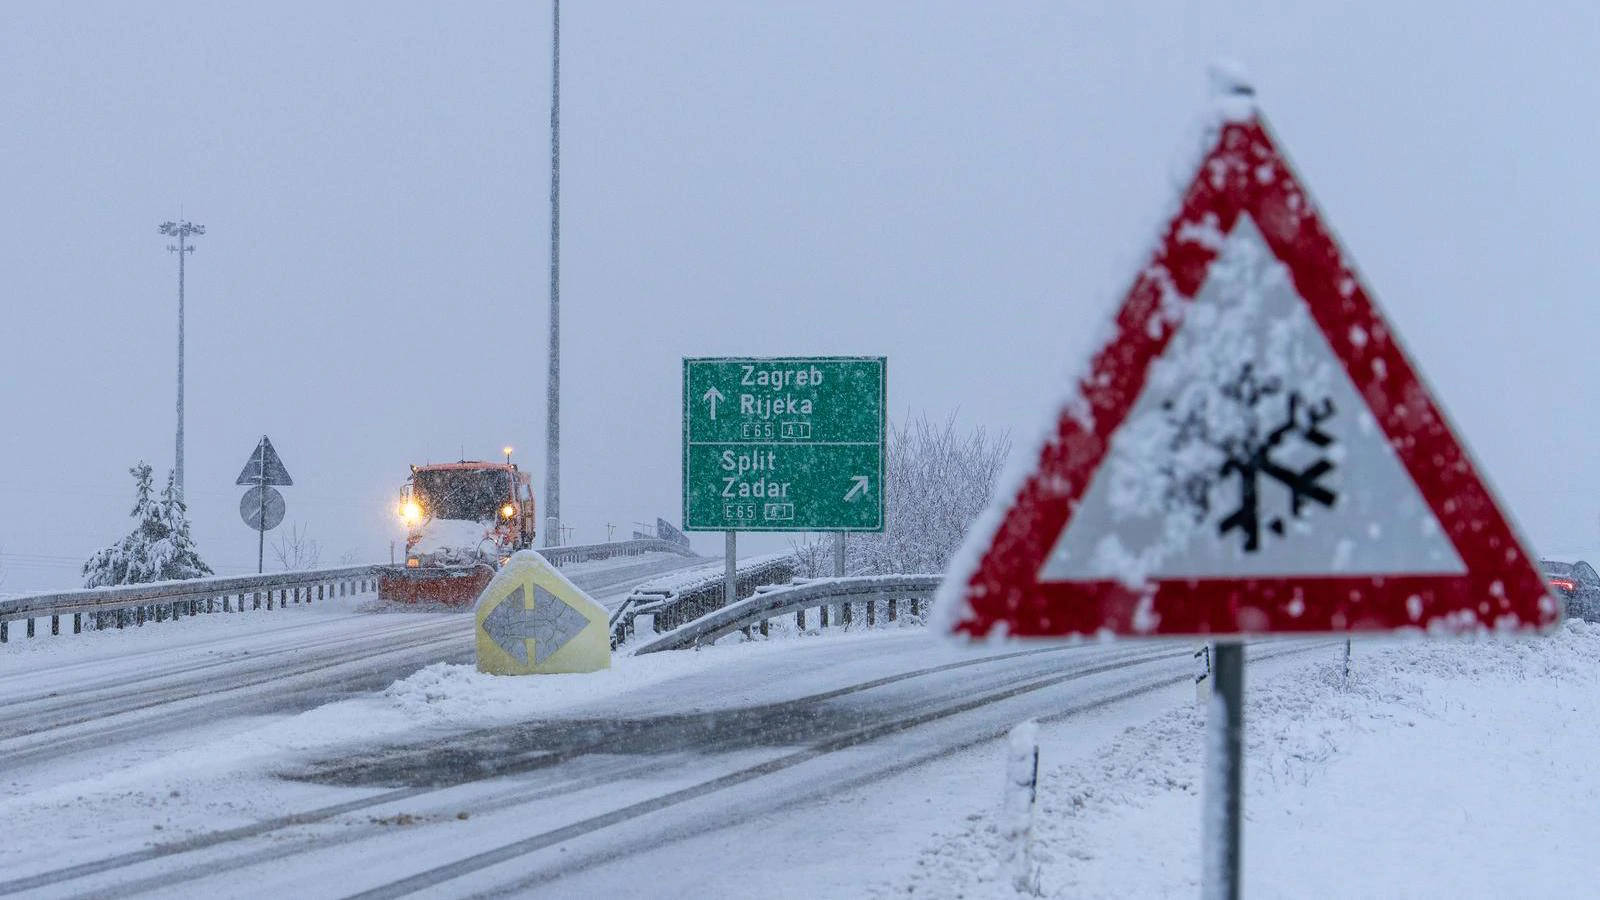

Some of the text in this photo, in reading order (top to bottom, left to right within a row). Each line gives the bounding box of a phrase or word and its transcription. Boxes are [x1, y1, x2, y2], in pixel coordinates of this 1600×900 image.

[741, 365, 823, 391] Zagreb
[740, 394, 813, 419] Rijeka
[721, 450, 777, 475] Split
[721, 477, 791, 498] Zadar
